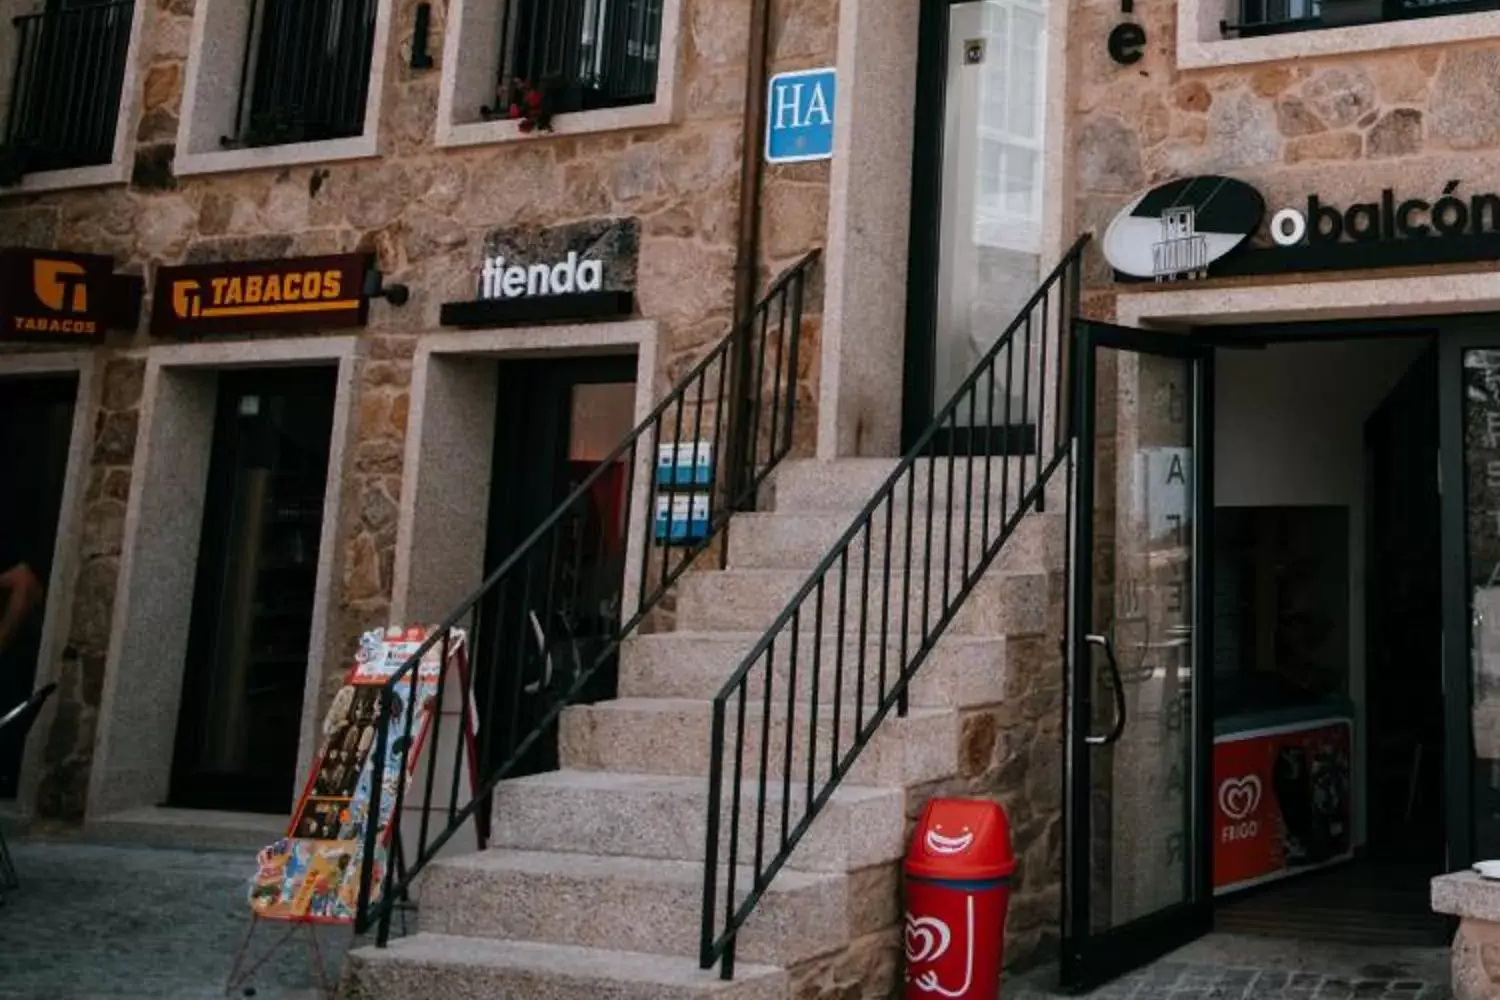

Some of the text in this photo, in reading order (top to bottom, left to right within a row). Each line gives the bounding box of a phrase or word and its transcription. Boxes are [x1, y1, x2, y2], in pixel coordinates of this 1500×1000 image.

[774, 81, 831, 130] HA
[212, 270, 341, 305] TABACOS
[482, 251, 602, 299] tienda
[14, 316, 96, 333] TABACOS
[1221, 821, 1259, 844] FRIGO
